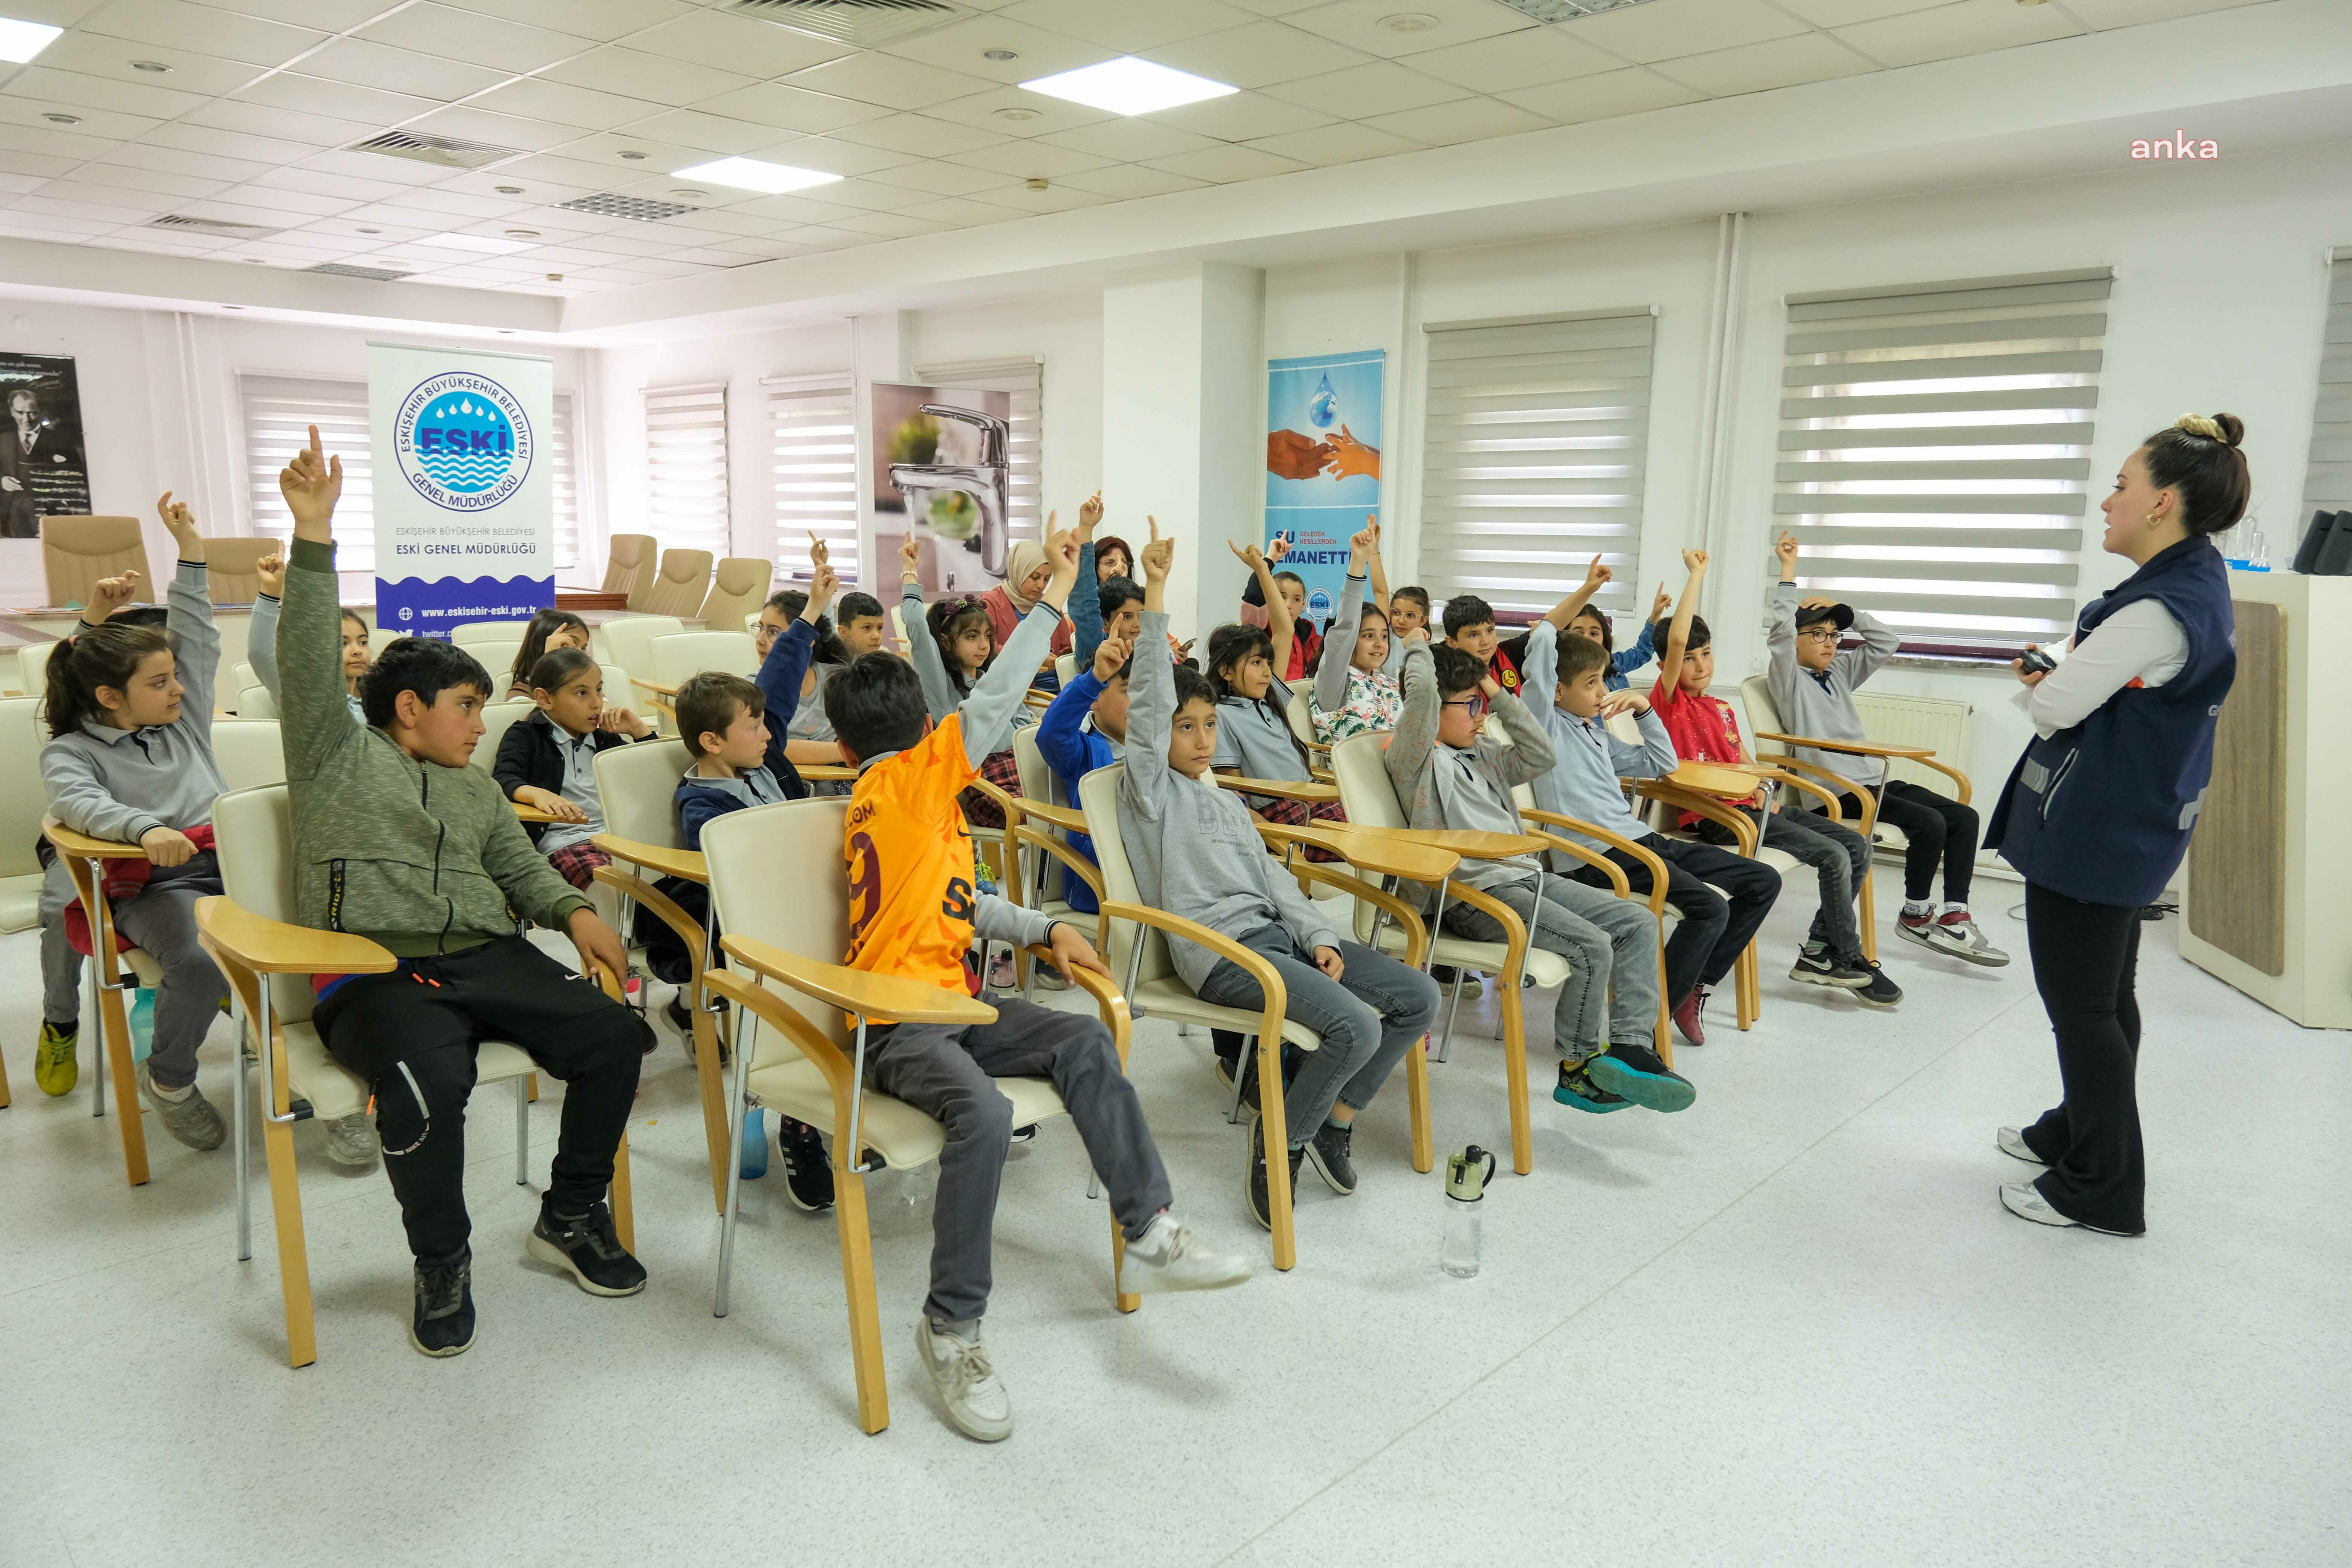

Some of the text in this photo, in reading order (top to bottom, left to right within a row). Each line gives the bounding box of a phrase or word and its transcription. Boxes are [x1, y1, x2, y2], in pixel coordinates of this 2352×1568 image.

[400, 377, 528, 459] ESKİŞEHİR BÜYÜKŞEHİR BELEDİYESİ
[422, 425, 507, 456] ESKİ
[413, 473, 517, 507] GENEL MÜDÜRLÜĞÜ
[396, 526, 535, 537] ESKİŞEHİR BÜYÜKŞEHİR BELEDİYESİ
[397, 542, 536, 554] ESKİ GENEL MÜDÜRLÜĞÜ
[421, 605, 537, 617] www.eskisehir-eski.gov.tr
